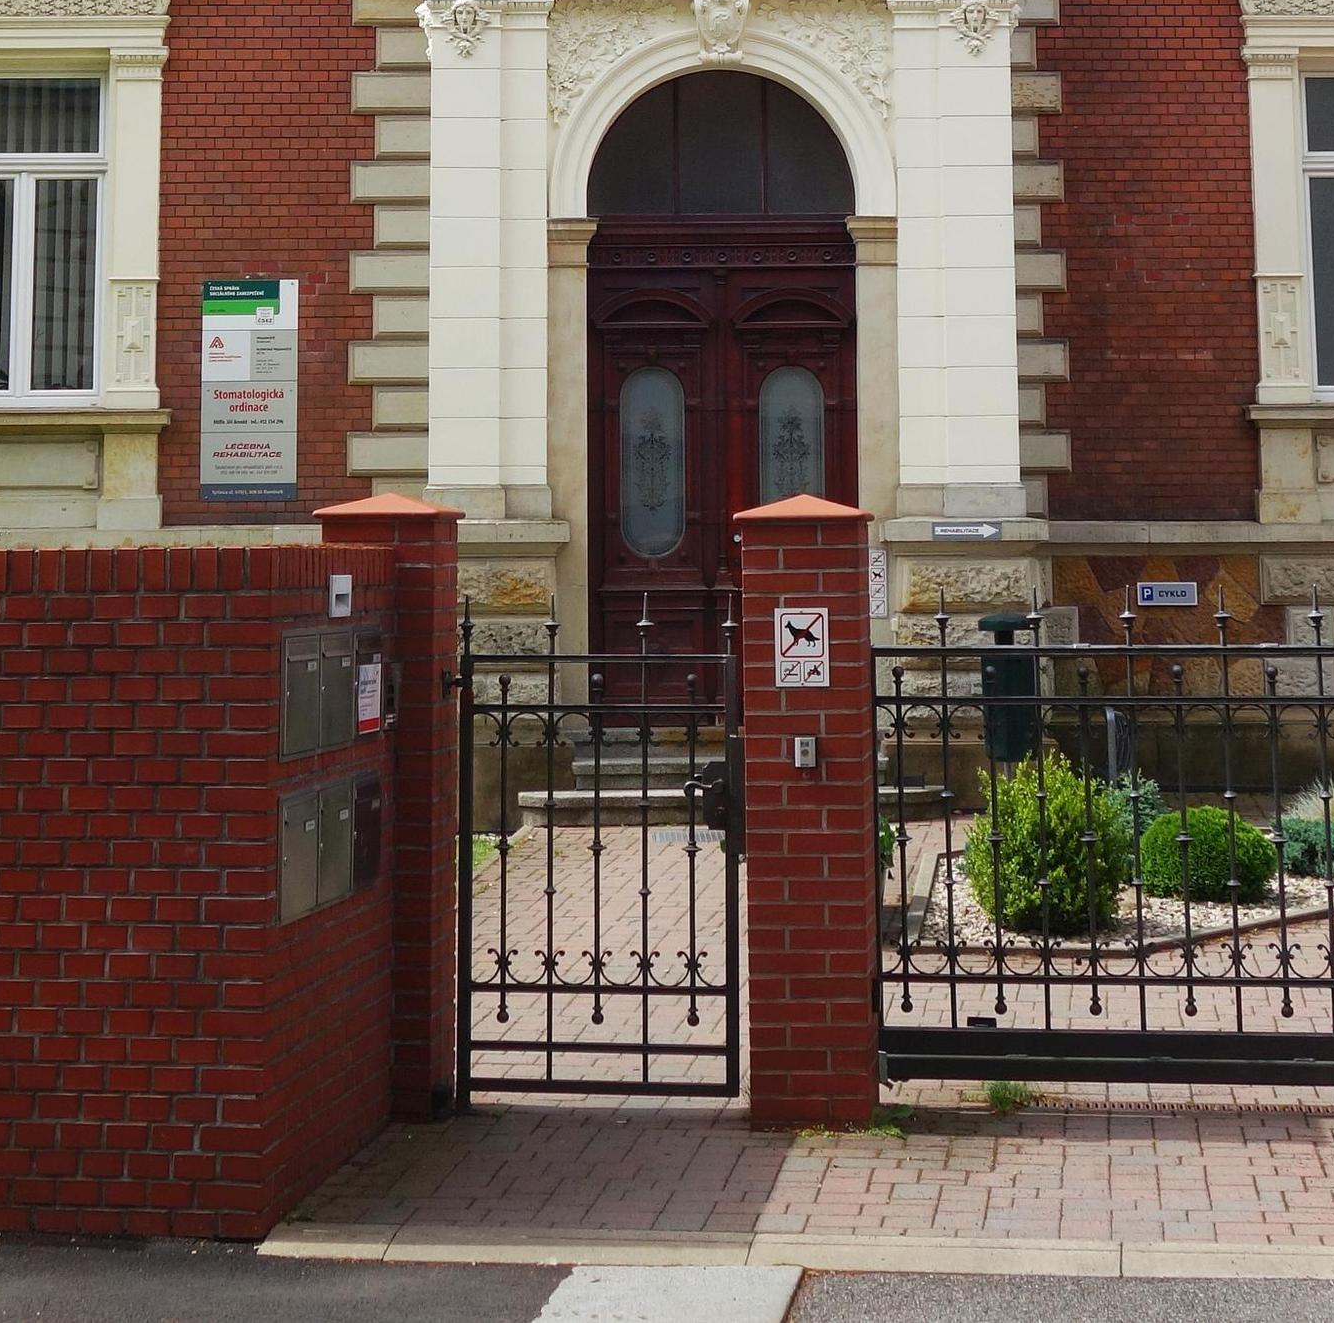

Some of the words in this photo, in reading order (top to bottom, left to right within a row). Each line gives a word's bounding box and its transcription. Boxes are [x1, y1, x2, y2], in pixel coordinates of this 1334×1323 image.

[213, 388, 284, 402] Stomatologická
[229, 401, 269, 413] ordinace
[1143, 588, 1152, 599] P
[1158, 590, 1187, 598] CYKLO
